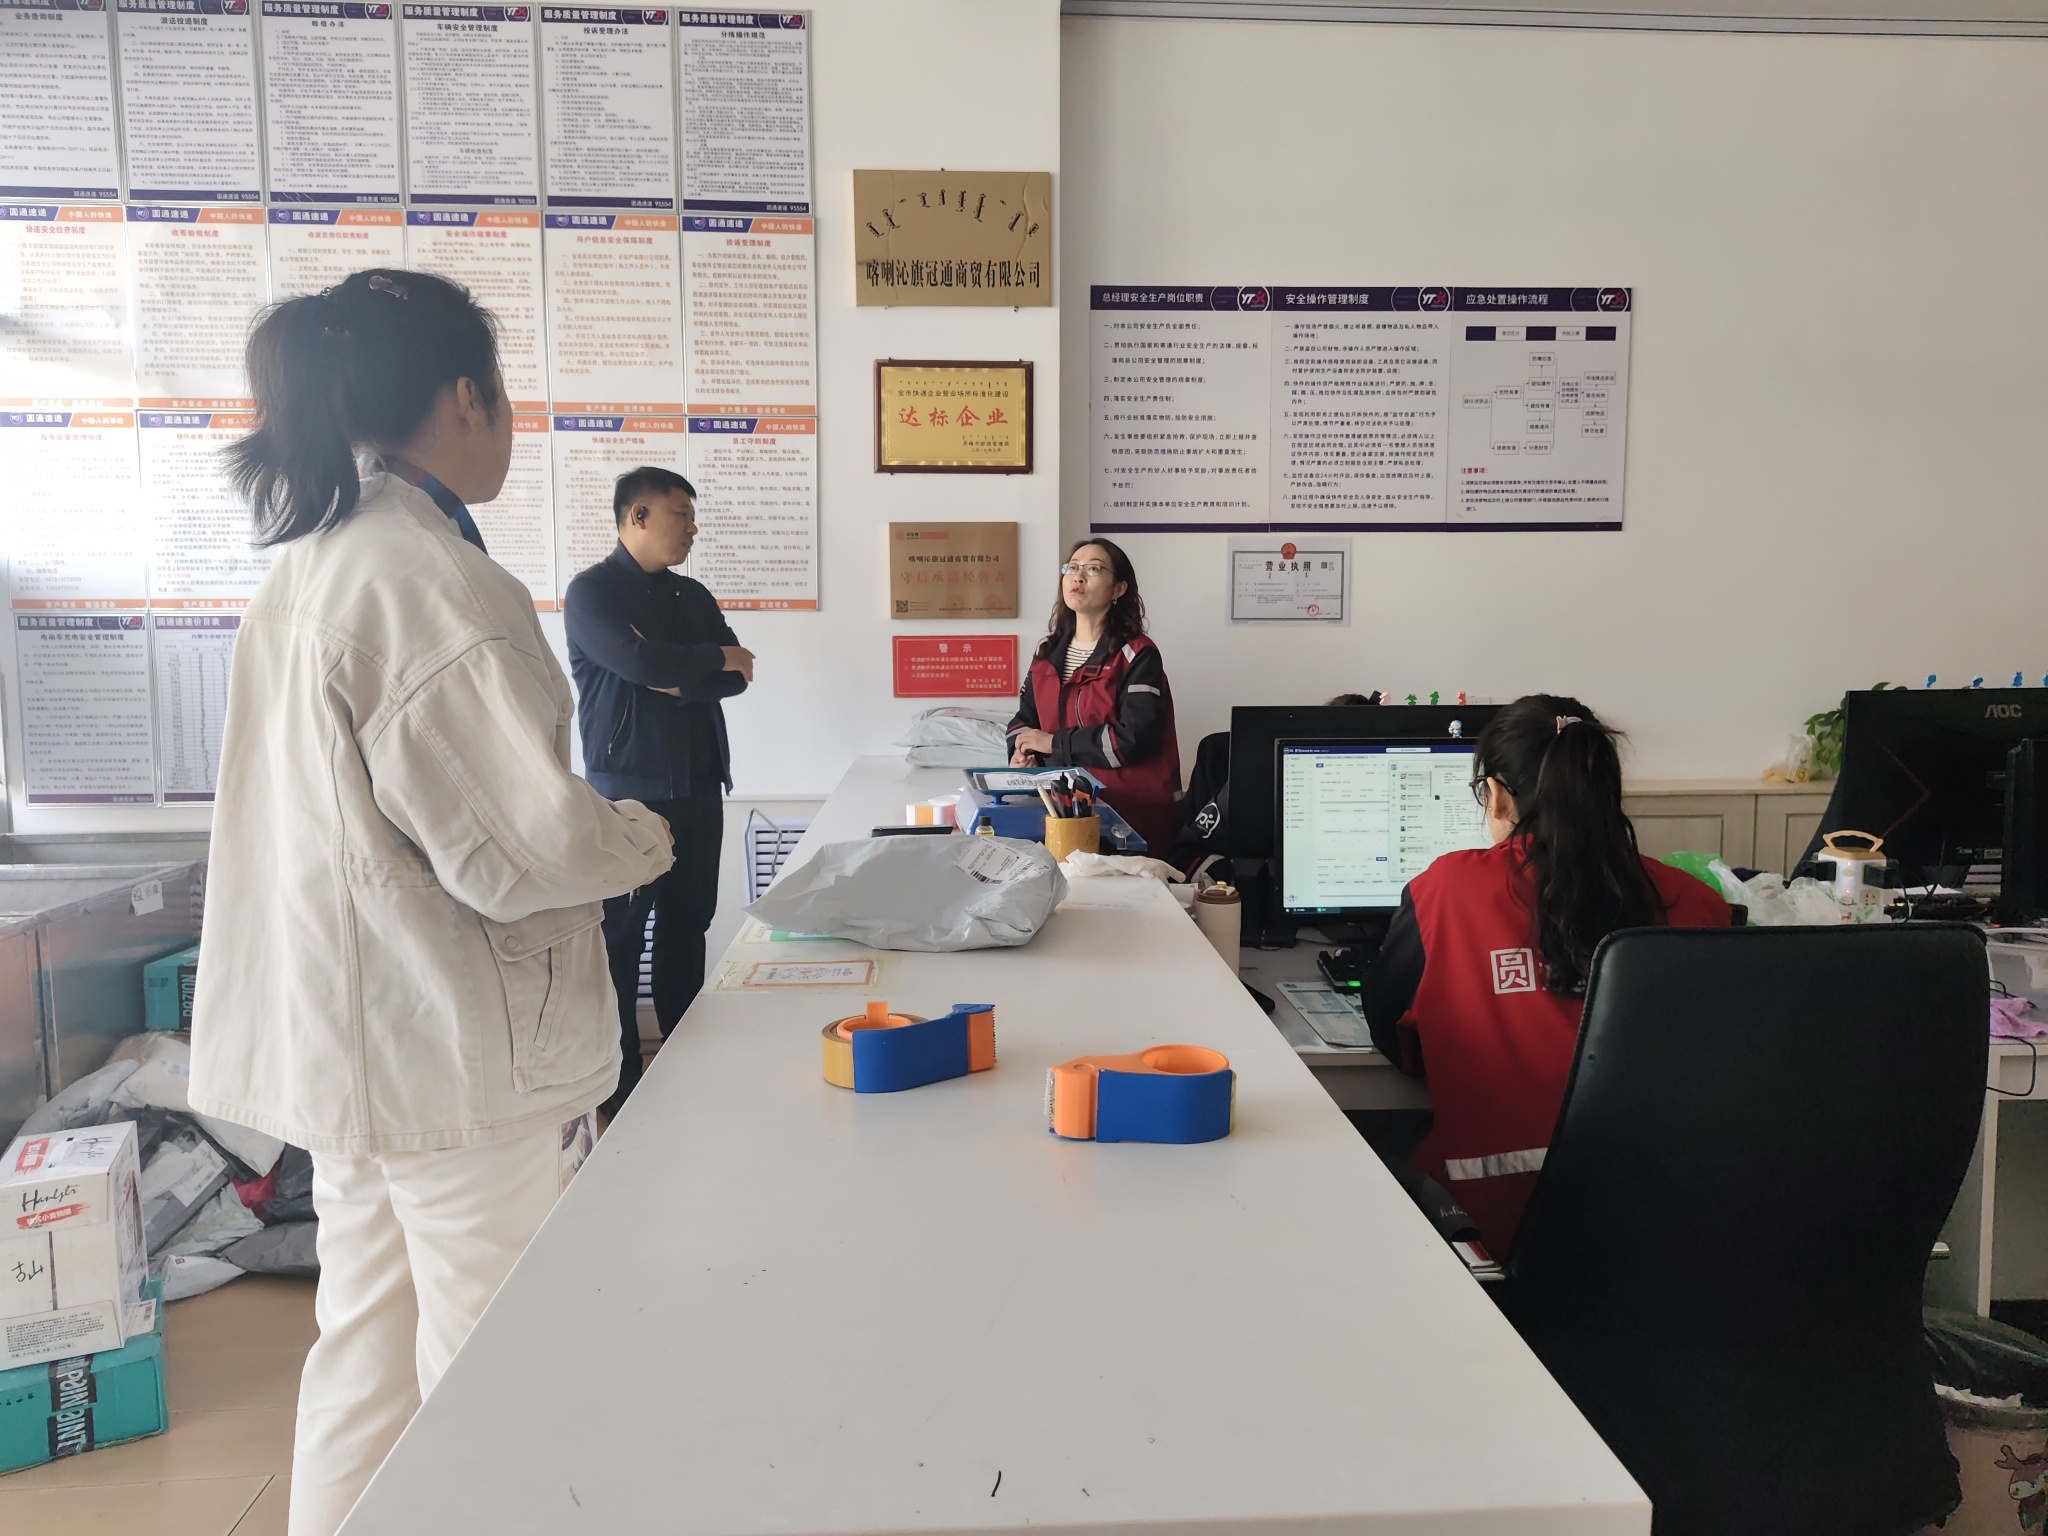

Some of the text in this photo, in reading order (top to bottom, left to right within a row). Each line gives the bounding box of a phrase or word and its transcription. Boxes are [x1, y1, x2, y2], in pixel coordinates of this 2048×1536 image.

[264, 3, 339, 14] 服务质量管理制度
[404, 6, 478, 17] 服务质量管理制度
[15, 12, 63, 21] 业务查询制度
[543, 9, 617, 21] 服务质量管理制度
[681, 13, 754, 25] 服务质量管理制度
[160, 16, 208, 26] 派送投递制度
[436, 23, 498, 32] 车辆安全管理制度
[583, 26, 629, 35] 投诉受理办法
[9, 208, 47, 218] 圆通速递
[152, 209, 190, 219] 圆通速递
[292, 211, 329, 221] 圆通速递
[433, 212, 469, 223] 圆通速递
[571, 215, 607, 226] 圆通速递
[708, 217, 744, 228] 圆通速递
[726, 238, 771, 248] 投诉受理制度
[867, 259, 1041, 289] 喀喇沁旗冠通商贸有限公司
[1102, 292, 1204, 303] 总经理安全生产岗位职责
[1285, 293, 1369, 305] 安全操作管理制度
[1466, 294, 1549, 306] 应急处置操作流程
[898, 405, 1009, 428] 达标企业
[578, 418, 613, 430] 圆通速递
[713, 419, 748, 430] 圆通速递
[733, 437, 776, 446] 员工守则制度
[1265, 561, 1312, 572] 营业执照
[1985, 704, 2022, 719] AOC
[1490, 947, 1536, 994] 圆
